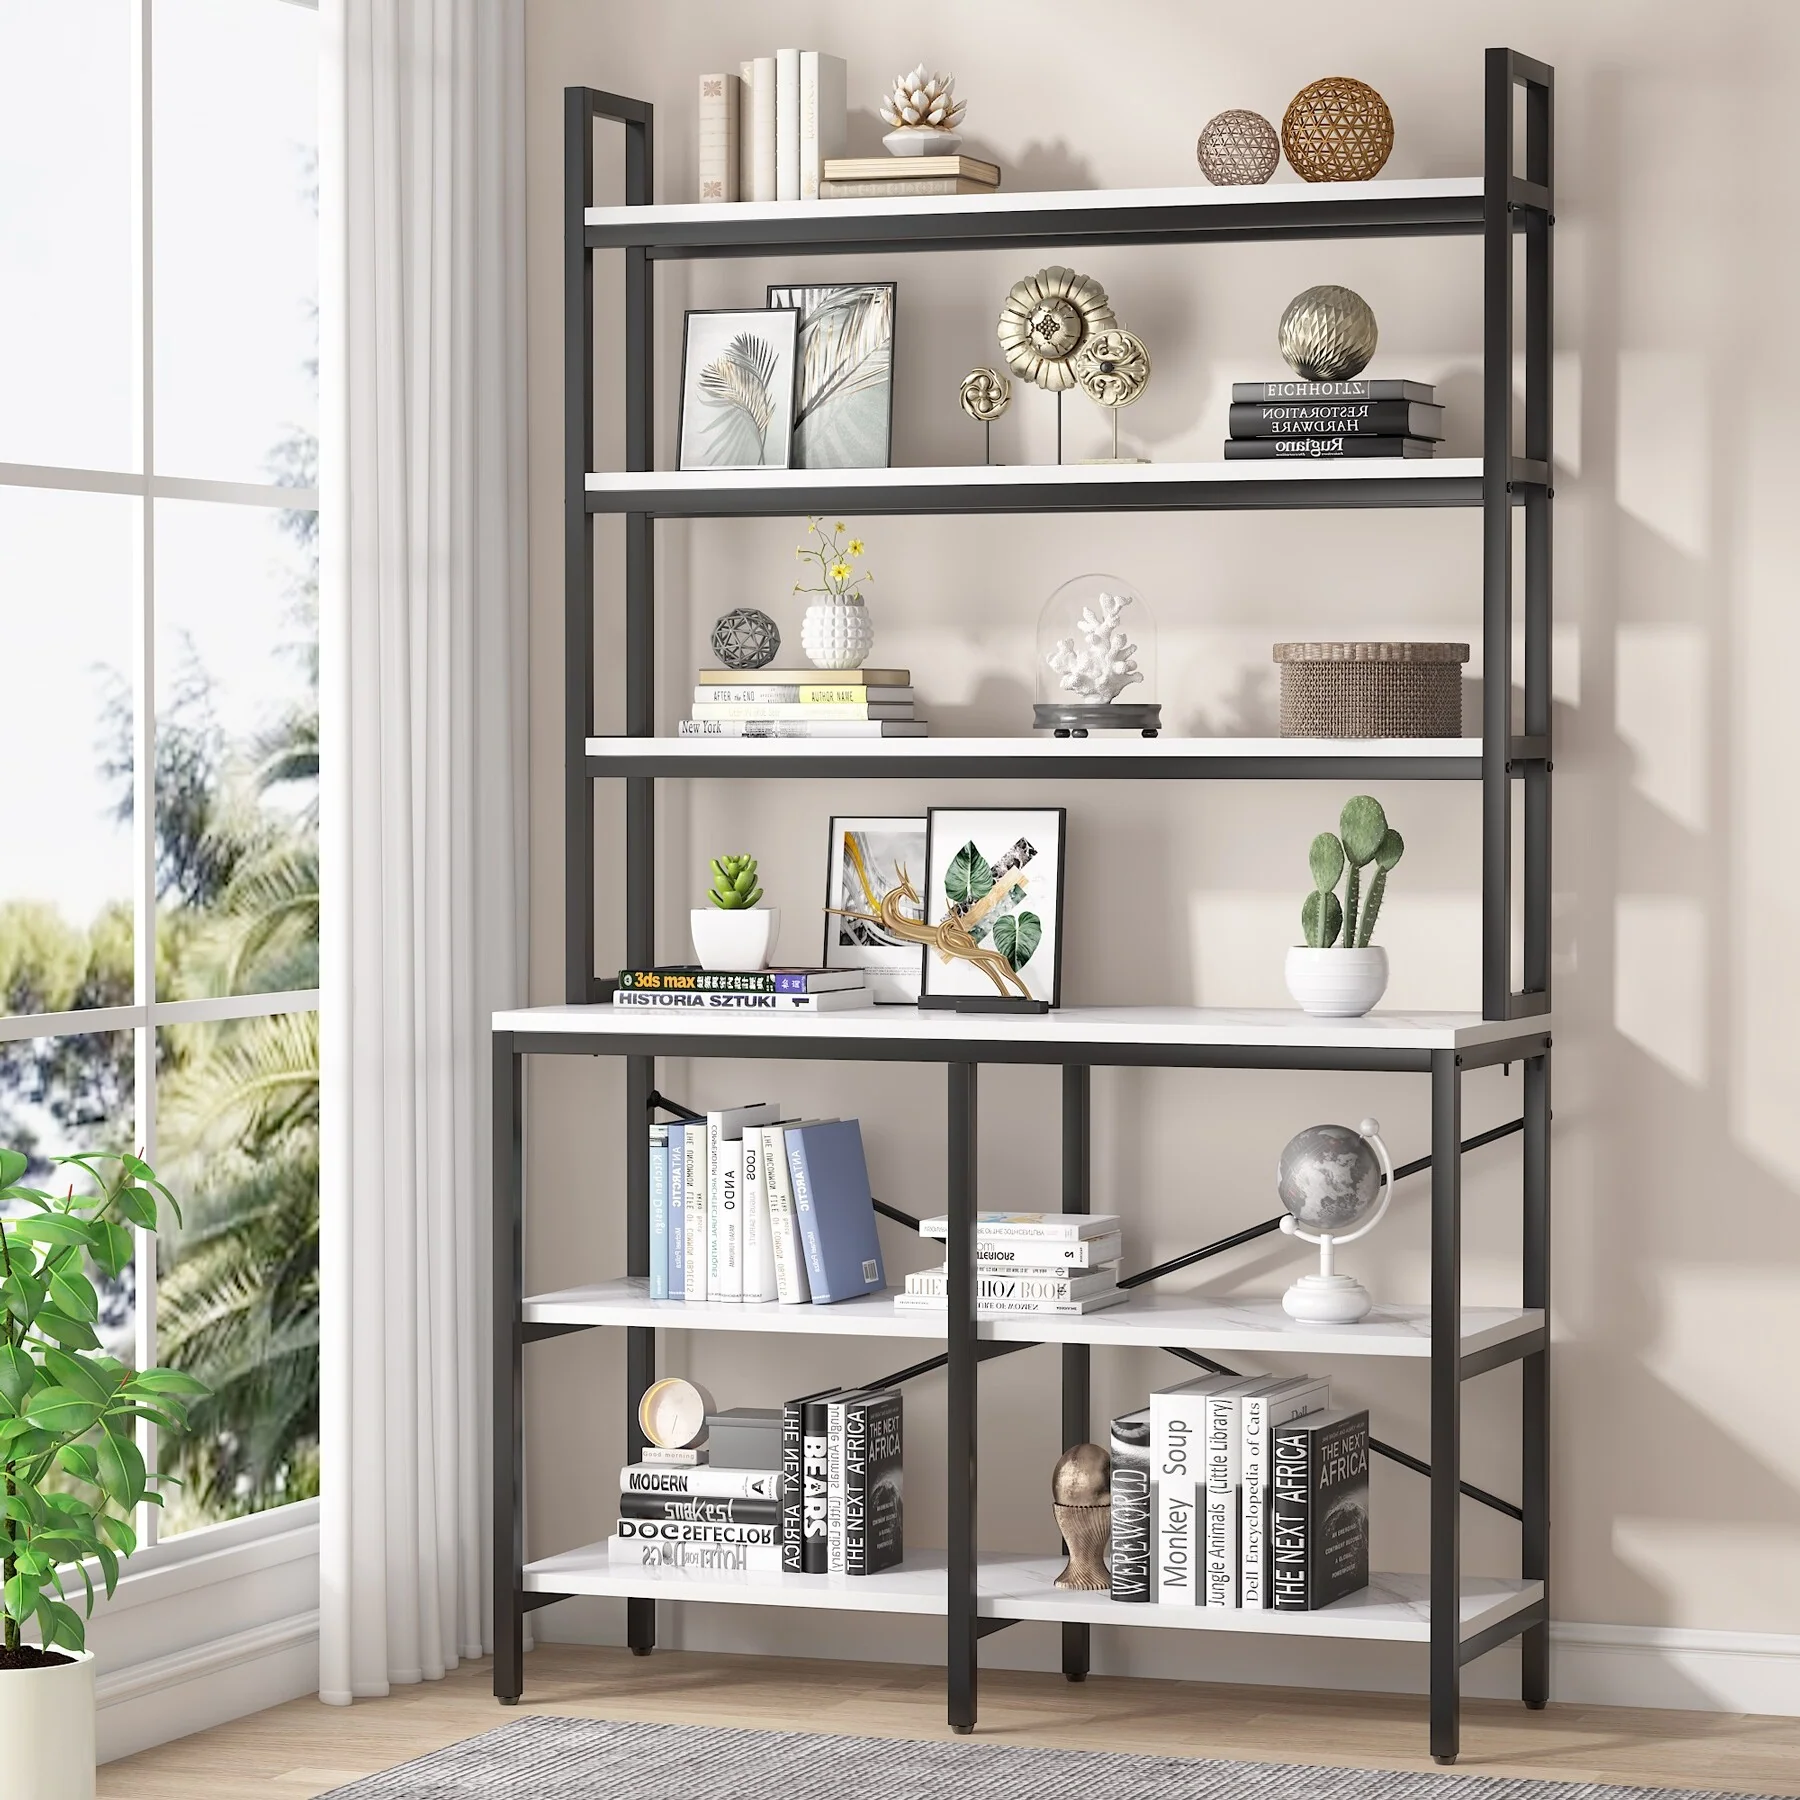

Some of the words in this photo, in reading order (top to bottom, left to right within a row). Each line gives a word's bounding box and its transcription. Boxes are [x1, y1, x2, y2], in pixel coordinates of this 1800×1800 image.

[713, 691, 731, 702] AFTER
[743, 691, 755, 702] END
[811, 691, 834, 702] AUTHOR
[836, 691, 854, 702] NAME
[682, 721, 700, 733] New
[702, 721, 721, 733] York
[634, 972, 661, 988] 3ds
[663, 974, 696, 989] max
[619, 992, 704, 1007] HISTORIA
[709, 995, 776, 1008] SZTUKI
[869, 1421, 882, 1438] THE
[883, 1415, 900, 1433] NEXT
[1209, 1400, 1233, 1452] Library)
[1247, 1402, 1260, 1436] Cats
[665, 1452, 695, 1460] morning
[847, 1410, 865, 1475] AFRICA
[868, 1433, 901, 1464] AFRICA
[1162, 1419, 1193, 1476] Soup
[1247, 1438, 1260, 1456] of
[1320, 1442, 1339, 1462] THE
[1341, 1431, 1366, 1452] NEXT
[629, 1473, 688, 1492] MODERN
[1209, 1453, 1233, 1495] (Little
[1275, 1434, 1308, 1503] AFRICA
[1319, 1449, 1368, 1489] AFRICA
[752, 1479, 765, 1495] A
[803, 1435, 828, 1538] BEARS
[664, 1497, 734, 1522] snakes!
[847, 1483, 864, 1531] NEXT
[1246, 1463, 1262, 1564] Encyclopedia
[1112, 1469, 1150, 1596] WEREWORLD
[1162, 1497, 1193, 1588] Monkey
[1208, 1503, 1226, 1558] Animals
[1275, 1512, 1305, 1563] NEXT
[847, 1537, 863, 1571] THE
[1208, 1560, 1230, 1606] Jungle
[1246, 1568, 1259, 1602] Dell
[1275, 1570, 1305, 1606] THE
